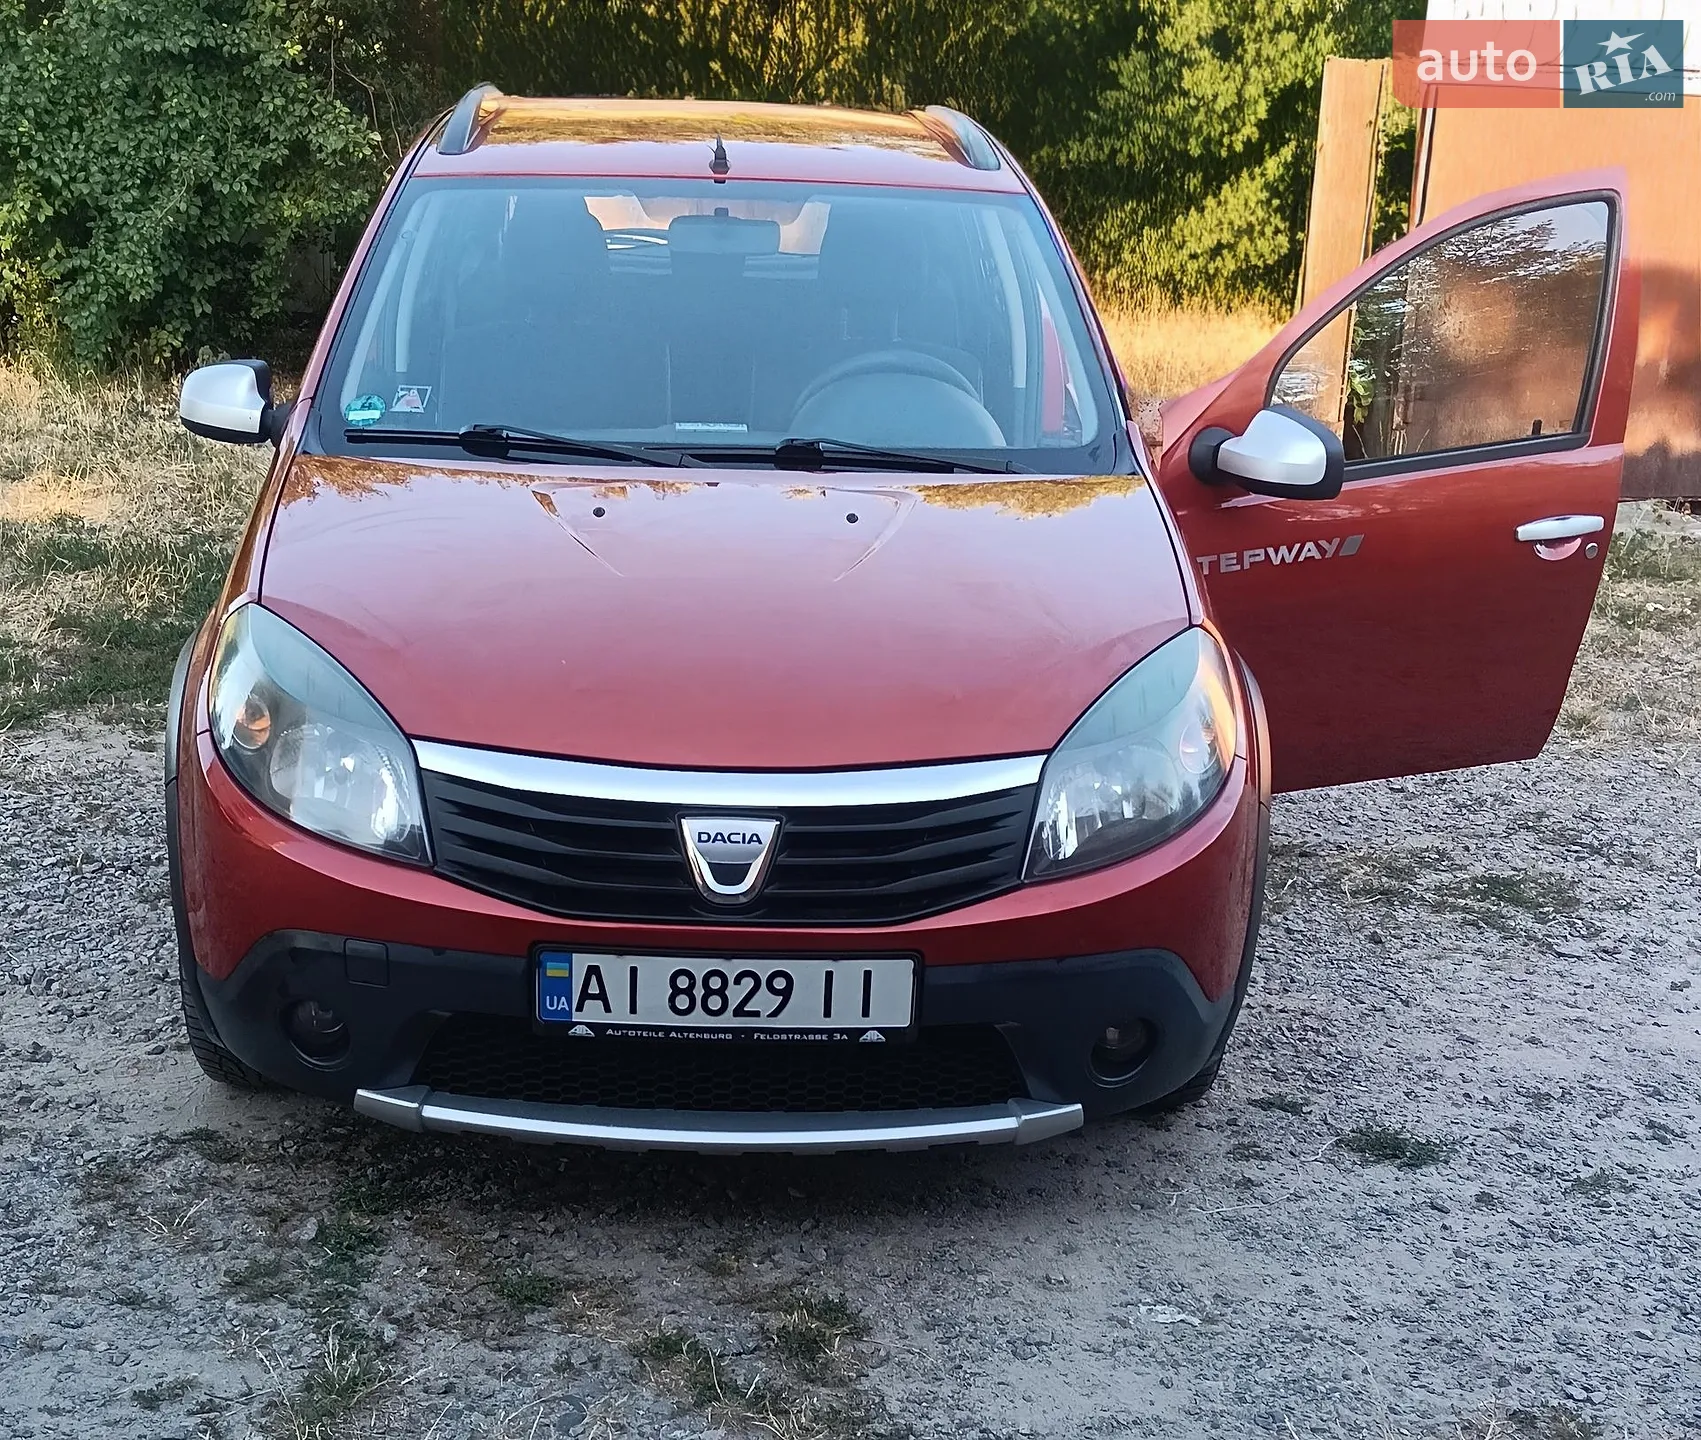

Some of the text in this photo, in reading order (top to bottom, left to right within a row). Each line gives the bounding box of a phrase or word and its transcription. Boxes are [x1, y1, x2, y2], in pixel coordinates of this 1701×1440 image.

[1196, 537, 1341, 576] TEPWAY
[697, 831, 763, 845] DACIA
[546, 995, 569, 1012] UA
[574, 964, 638, 1015] AI
[667, 967, 795, 1018] 8829
